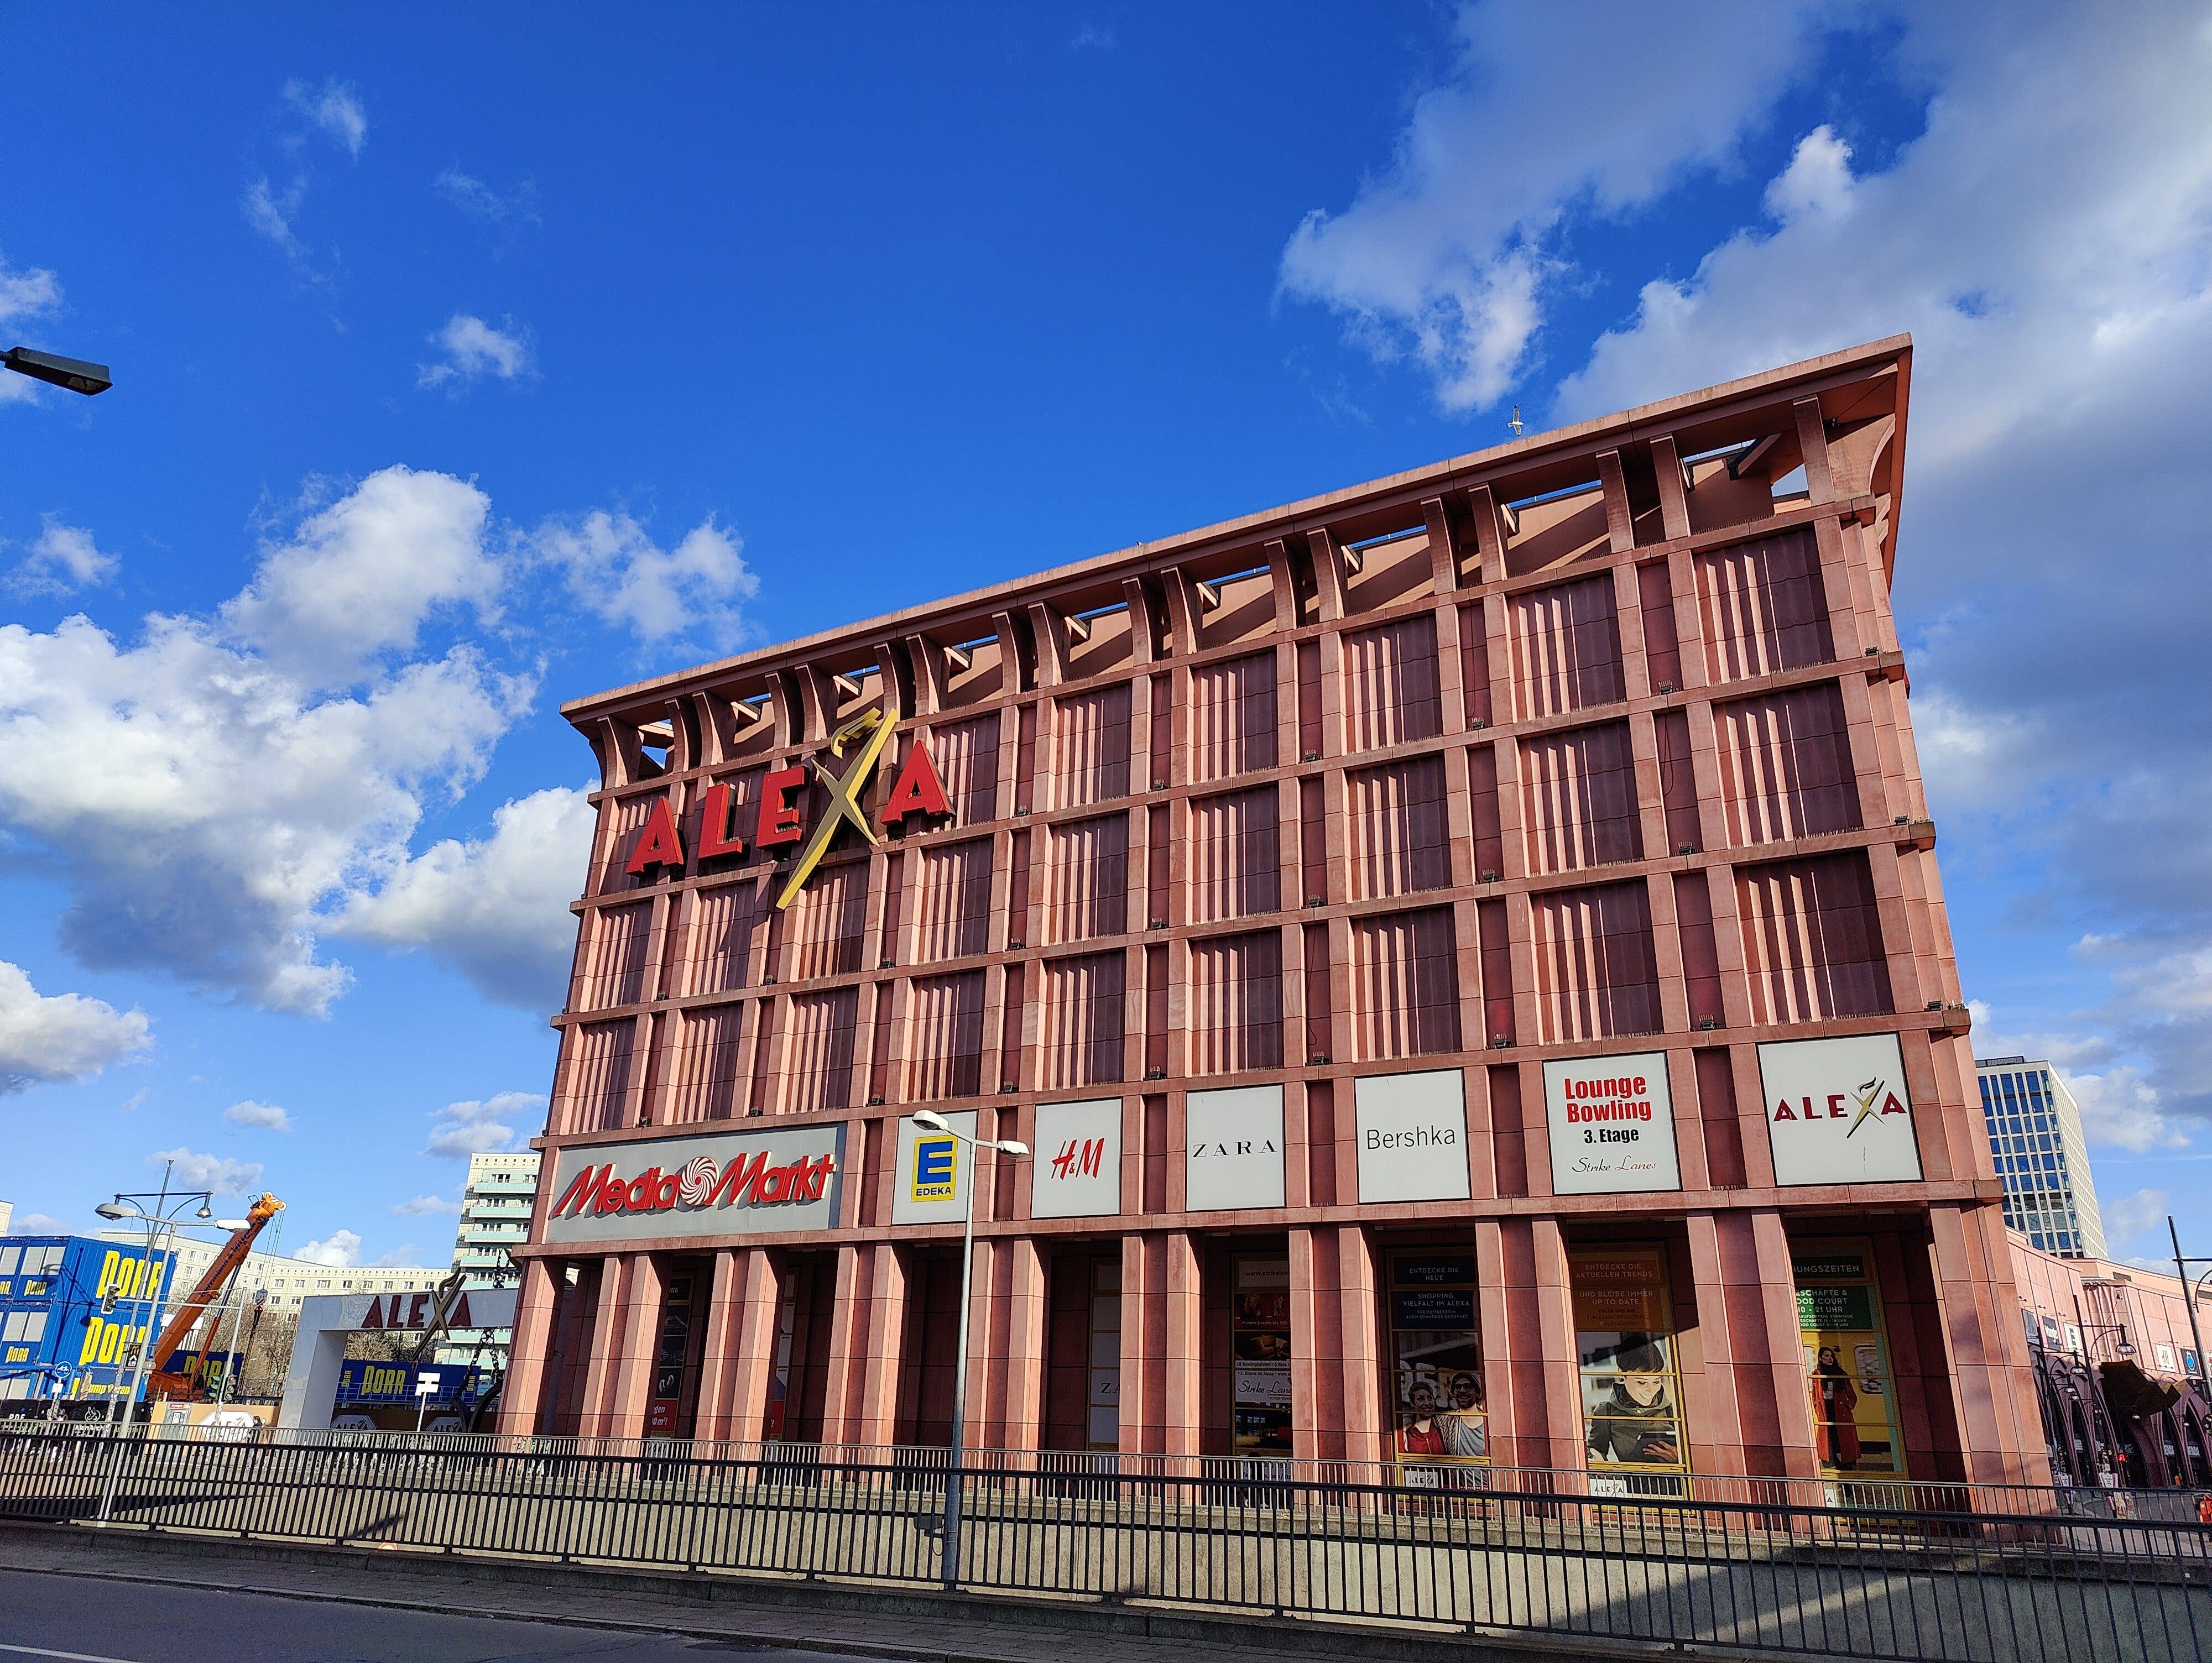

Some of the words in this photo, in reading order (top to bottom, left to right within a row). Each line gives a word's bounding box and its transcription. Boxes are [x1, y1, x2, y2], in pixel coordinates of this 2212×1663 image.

[625, 708, 956, 909] ALEXA
[1564, 1075, 1646, 1100] Lounge
[1567, 1099, 1652, 1123] Bowling
[1773, 1076, 1907, 1139] ALEXA
[1366, 1125, 1456, 1149] Bershka
[1584, 1129, 1597, 1144] 3.
[1599, 1128, 1639, 1143] Etage
[1051, 1137, 1105, 1180] H&M
[1192, 1139, 1277, 1158] ZARA
[1572, 1157, 1611, 1173] Strike
[1614, 1155, 1657, 1171] Lanes
[916, 1186, 952, 1196] EDEKA
[361, 1268, 472, 1360] ALEXA
[361, 1366, 406, 1395] PORR
[1237, 1380, 1265, 1393] Strike
